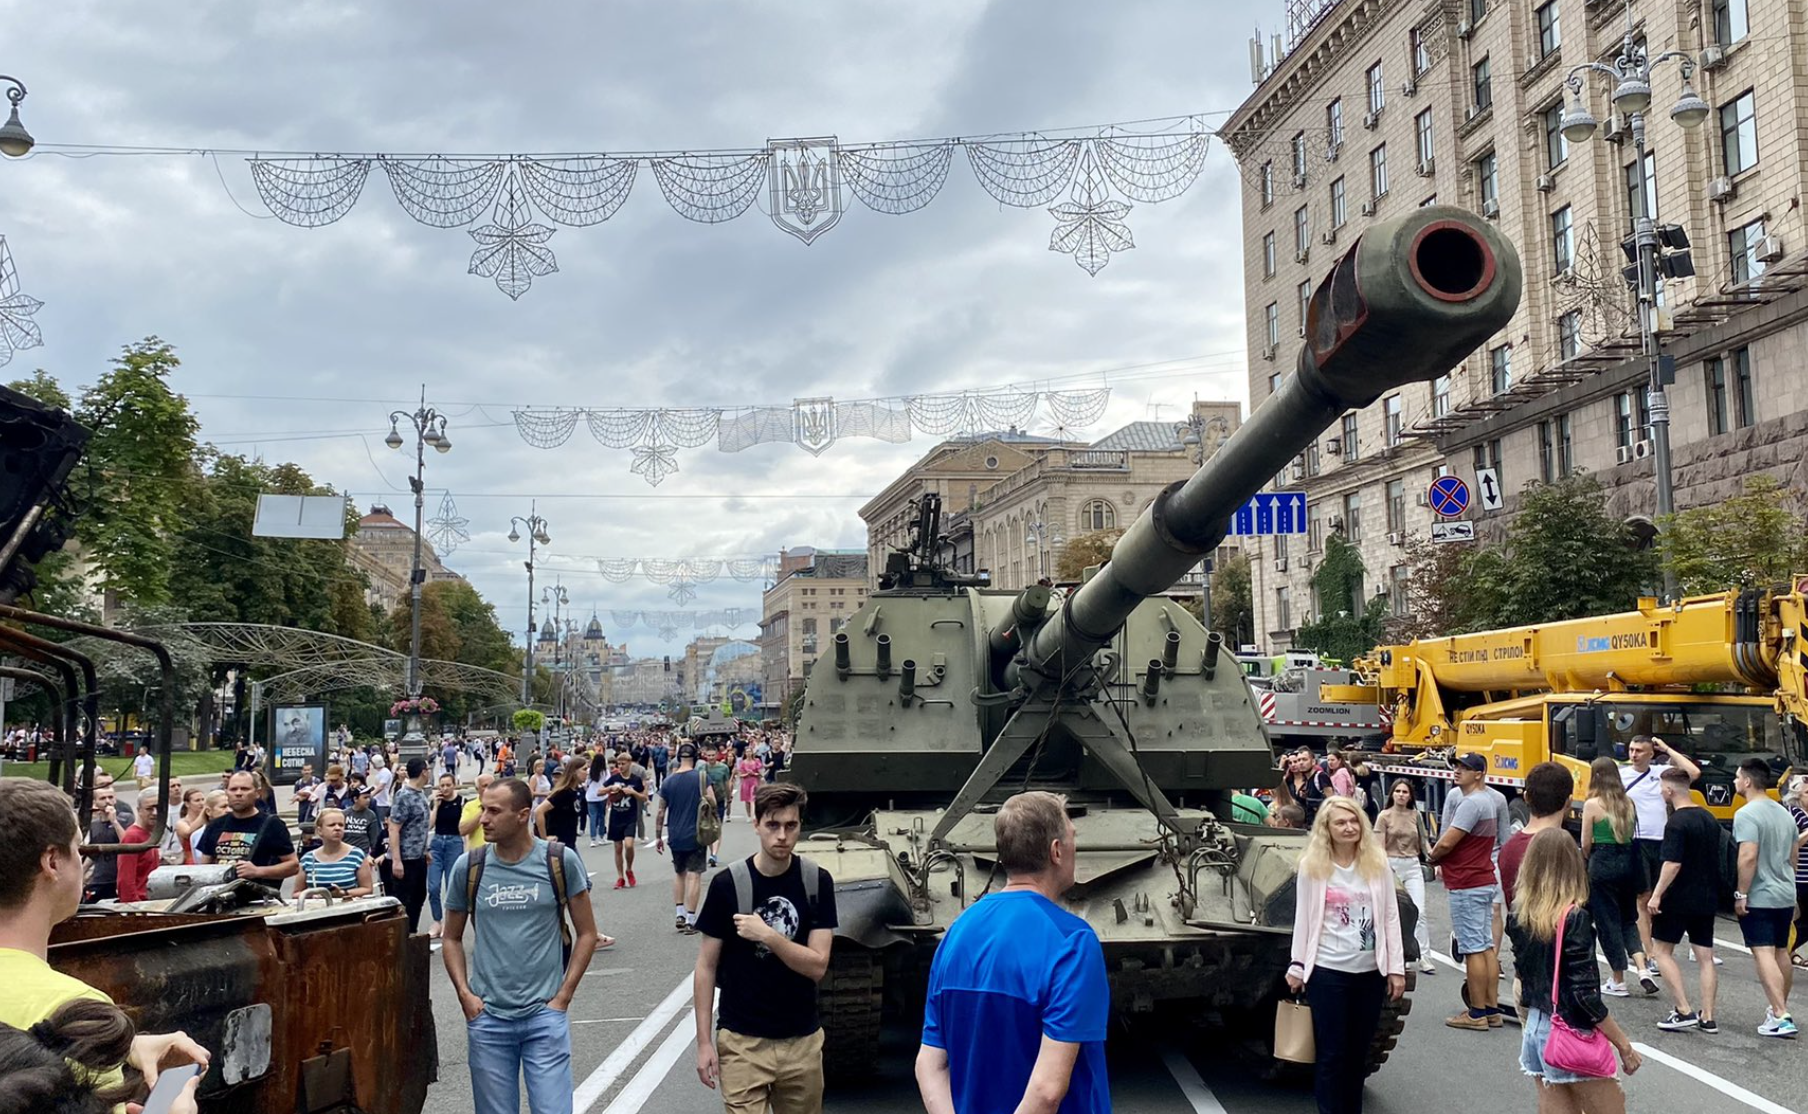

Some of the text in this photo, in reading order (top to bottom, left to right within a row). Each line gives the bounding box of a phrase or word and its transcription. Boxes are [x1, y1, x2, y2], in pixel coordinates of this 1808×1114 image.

[1611, 632, 1648, 650] QY50KA
[1449, 650, 1458, 663] НЕ
[1459, 650, 1475, 663] СТІЙ
[1307, 706, 1351, 715] ZOOMLION
[1465, 723, 1486, 735] QY50KA
[282, 747, 316, 757] НЕБЕСНА
[282, 757, 305, 768] СОТНЯ
